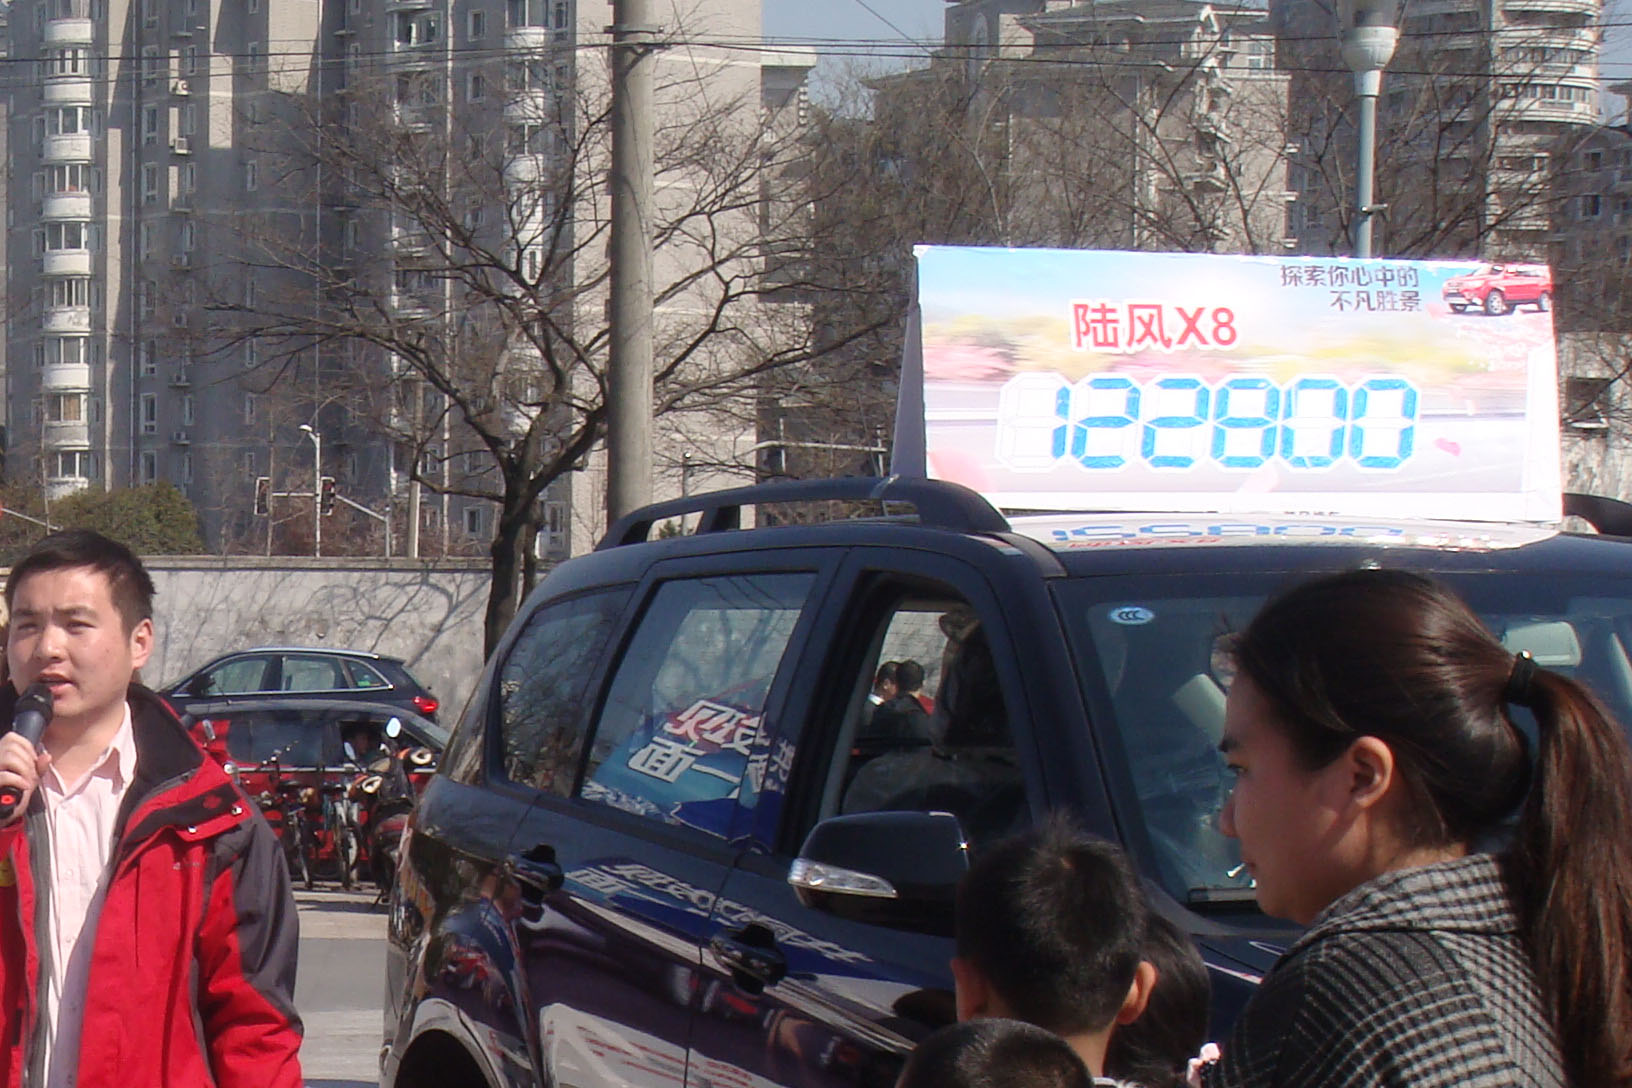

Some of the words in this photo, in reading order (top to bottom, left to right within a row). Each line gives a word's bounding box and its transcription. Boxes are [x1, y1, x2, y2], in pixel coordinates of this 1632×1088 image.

[1280, 264, 1419, 288] 探索你心中的
[1330, 290, 1422, 312] 不凡胜景
[1073, 302, 1238, 349] 陆风X8
[1052, 377, 1418, 469] 122800
